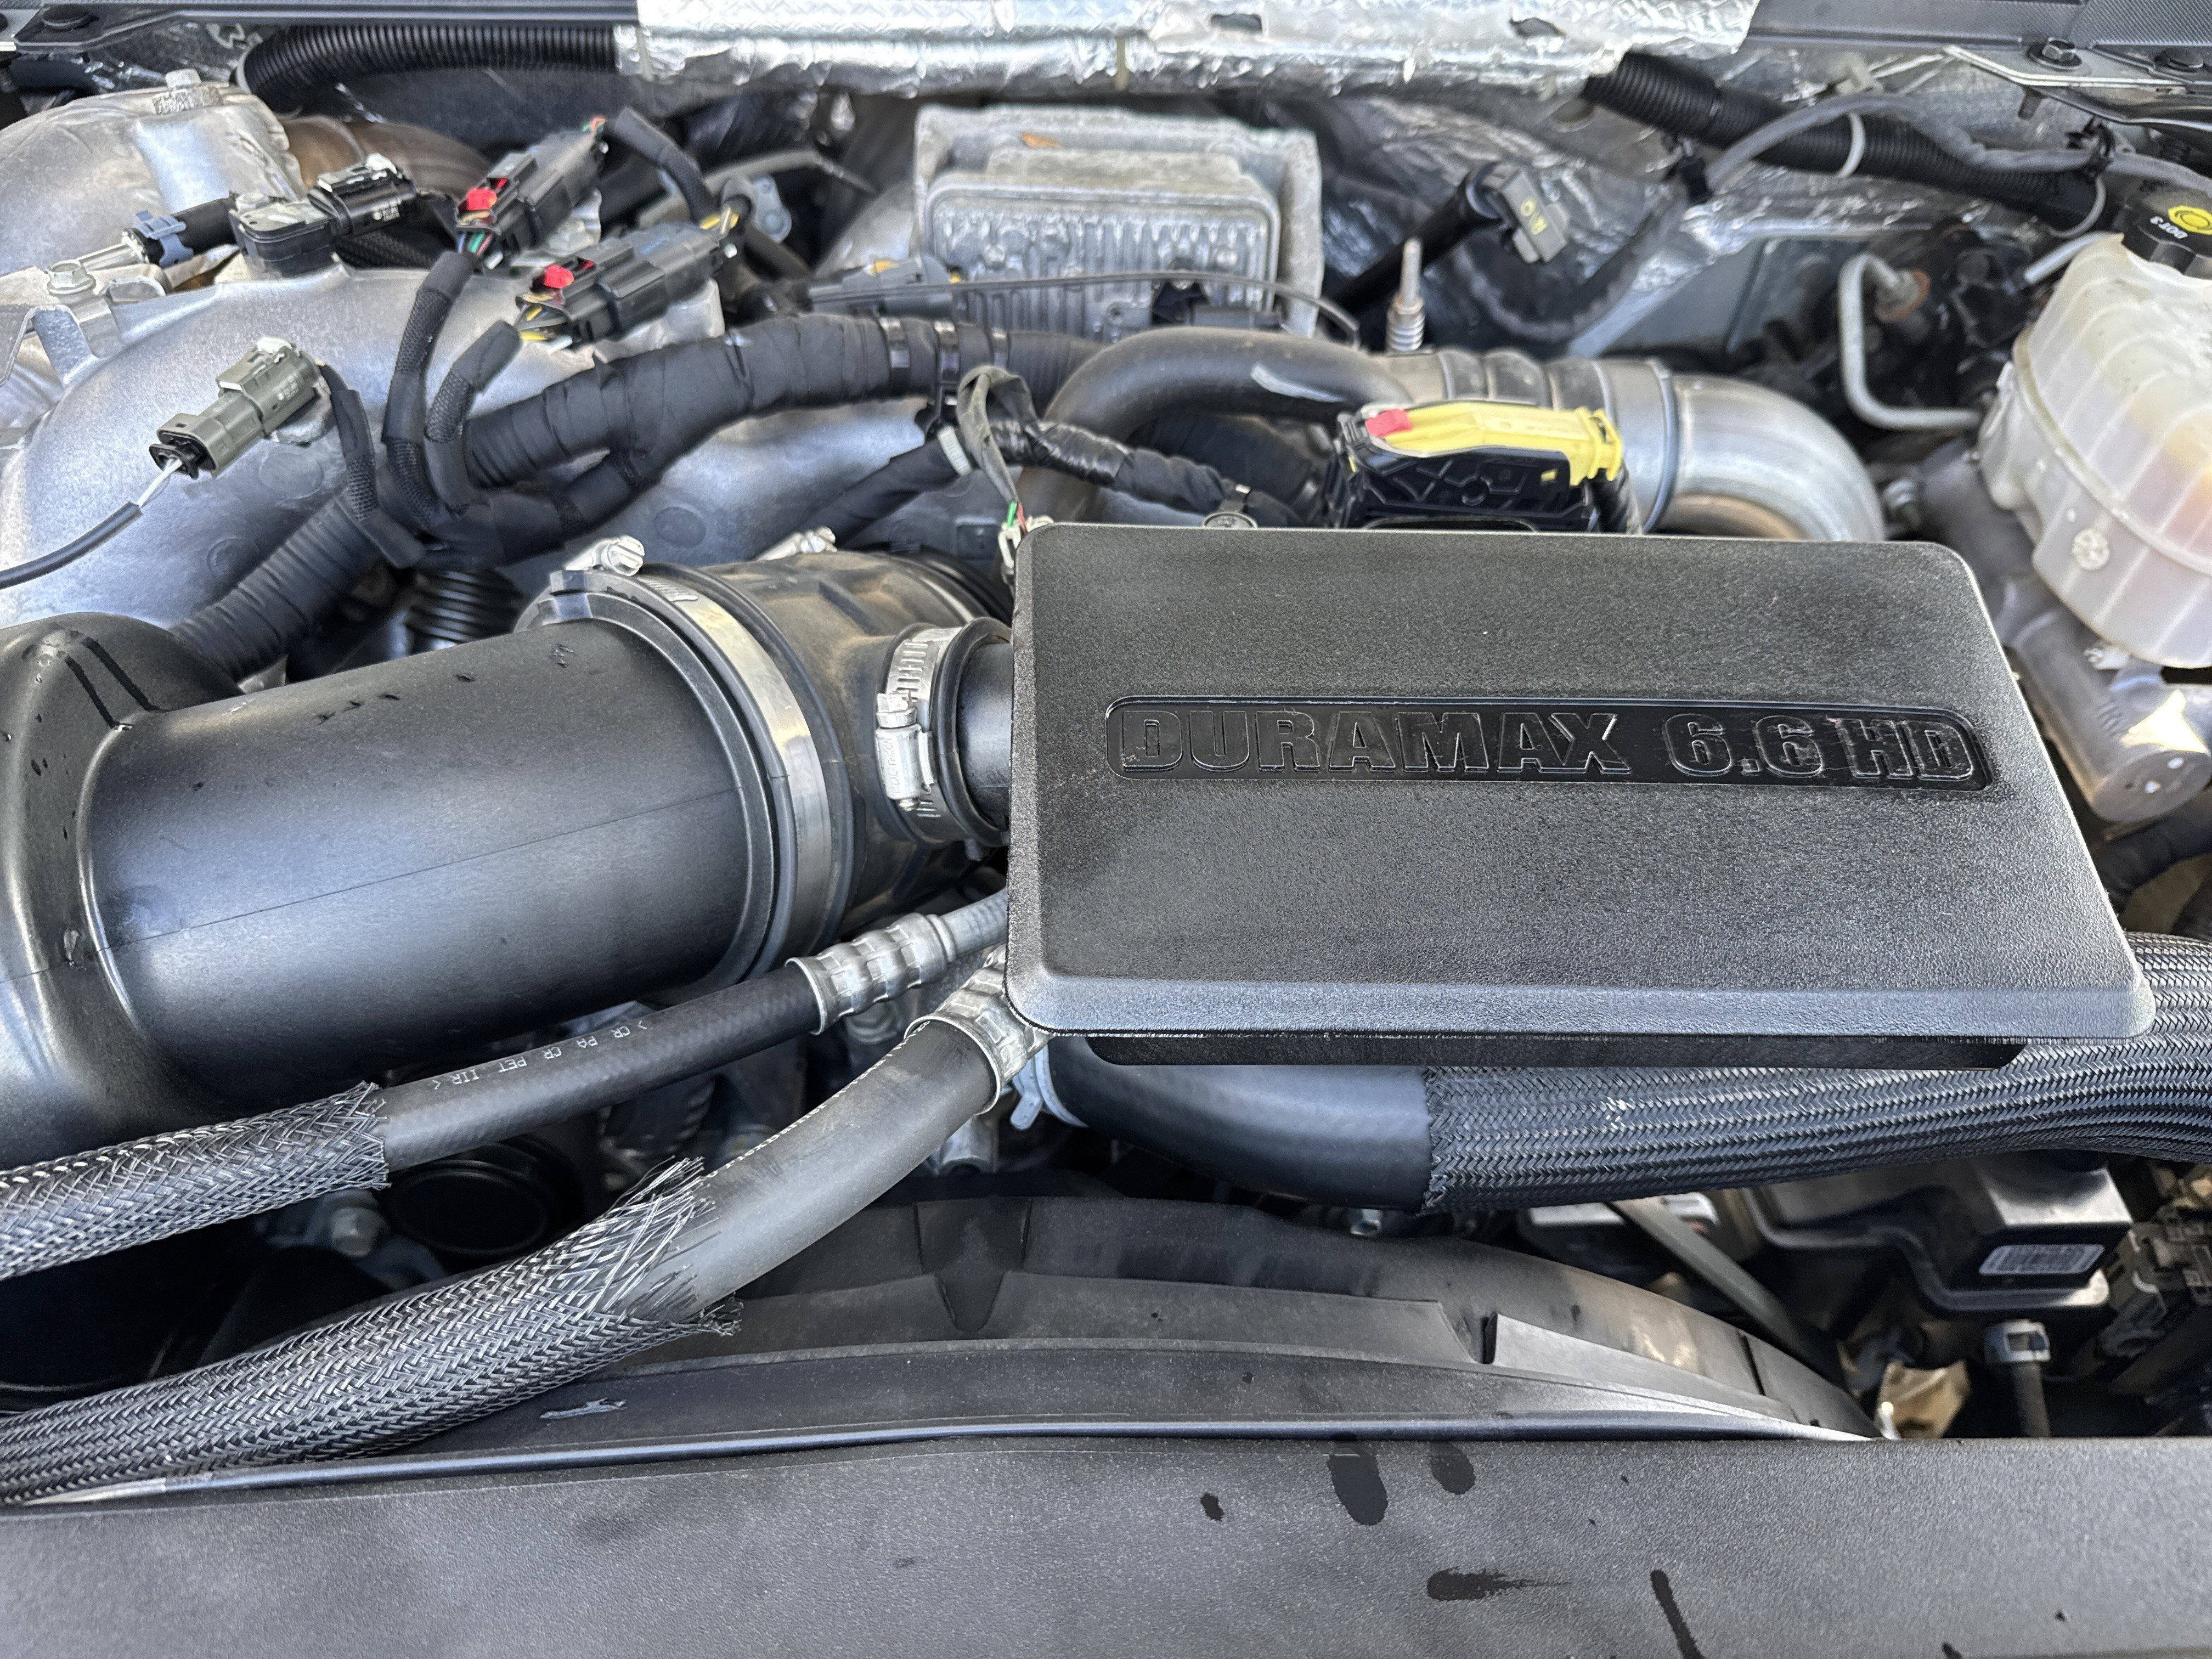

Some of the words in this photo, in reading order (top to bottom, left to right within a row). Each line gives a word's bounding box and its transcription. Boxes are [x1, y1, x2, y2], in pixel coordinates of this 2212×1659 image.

[2149, 216, 2188, 239] DOT3
[1122, 710, 1630, 775] DURAMAX
[1662, 713, 1825, 777] 6.6
[1826, 715, 1975, 782] HD
[610, 1025, 632, 1039] CR
[576, 1035, 599, 1049] PA
[541, 1046, 563, 1060] CR
[498, 1055, 527, 1073] PET
[452, 1068, 480, 1085] IIR
